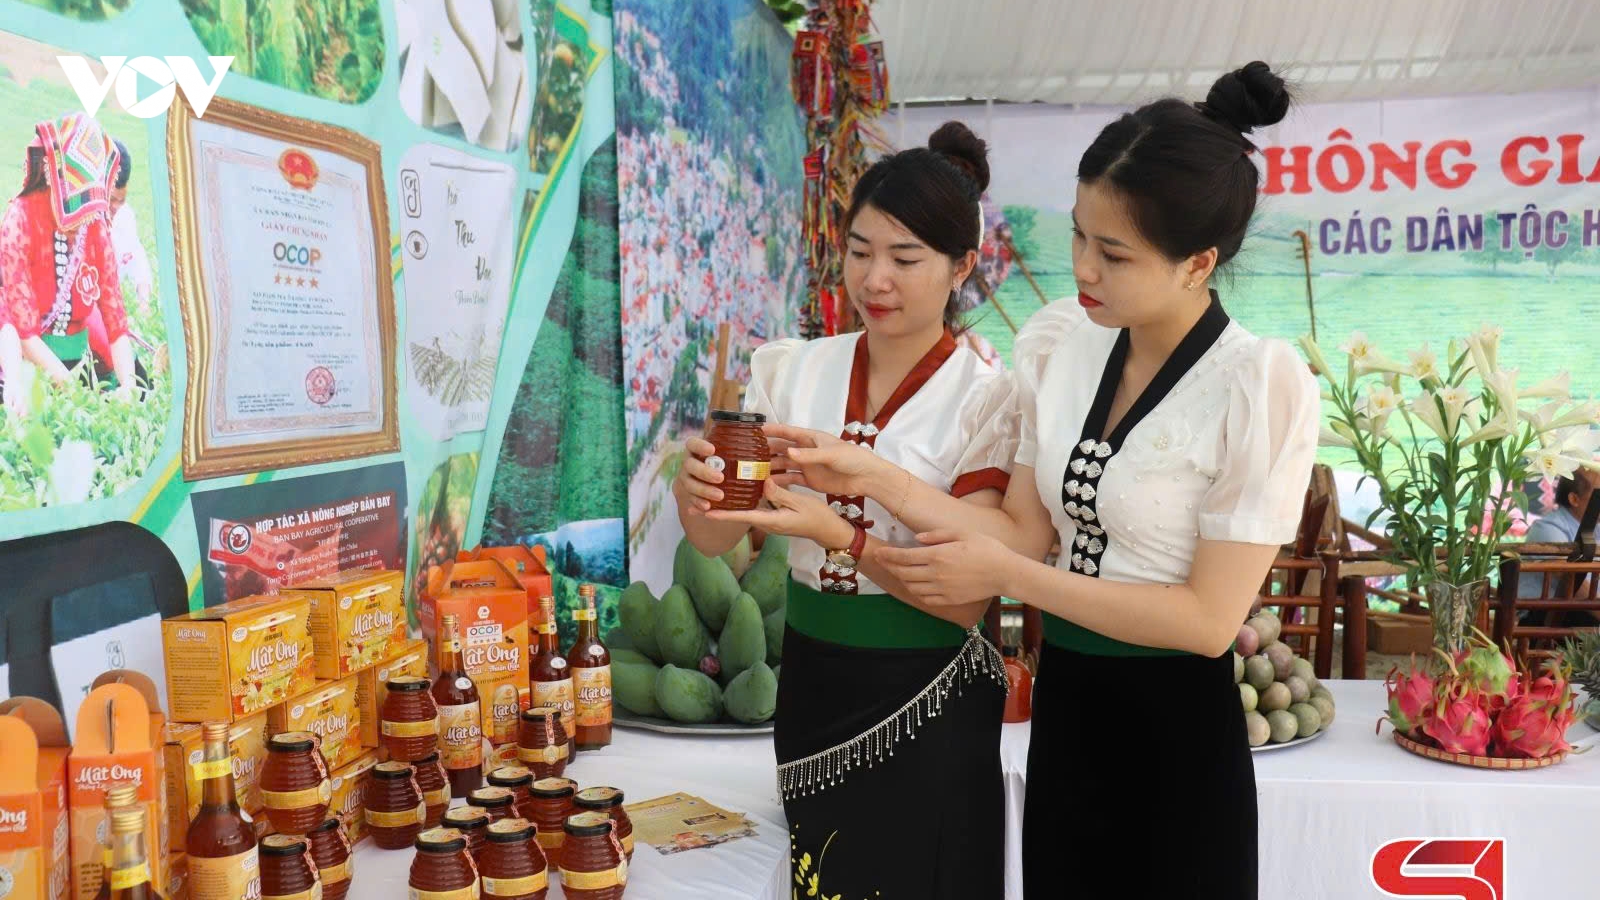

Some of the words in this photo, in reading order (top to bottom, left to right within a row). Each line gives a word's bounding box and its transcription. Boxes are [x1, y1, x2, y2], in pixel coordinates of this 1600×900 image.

[1250, 128, 1477, 195] HÔNG
[1319, 210, 1391, 254] CÁC
[1406, 207, 1484, 253] DÂN
[1496, 204, 1568, 258] TỘC
[273, 242, 321, 267] OCOP
[256, 519, 274, 535] HỢP
[276, 514, 295, 529] TÁC
[298, 511, 310, 526] XÃ
[312, 507, 335, 524] NÔNG
[336, 501, 358, 517] NGHIỆP
[360, 496, 376, 511] BẢN
[377, 495, 391, 508] BAY
[344, 512, 380, 528] COOPERATIVE
[374, 609, 393, 631] Ong
[470, 625, 500, 636] OCOP
[275, 639, 299, 662] Ong
[486, 643, 520, 664] Ong
[327, 714, 347, 734] Ong
[111, 764, 142, 785] Ong
[232, 756, 255, 780] Ong
